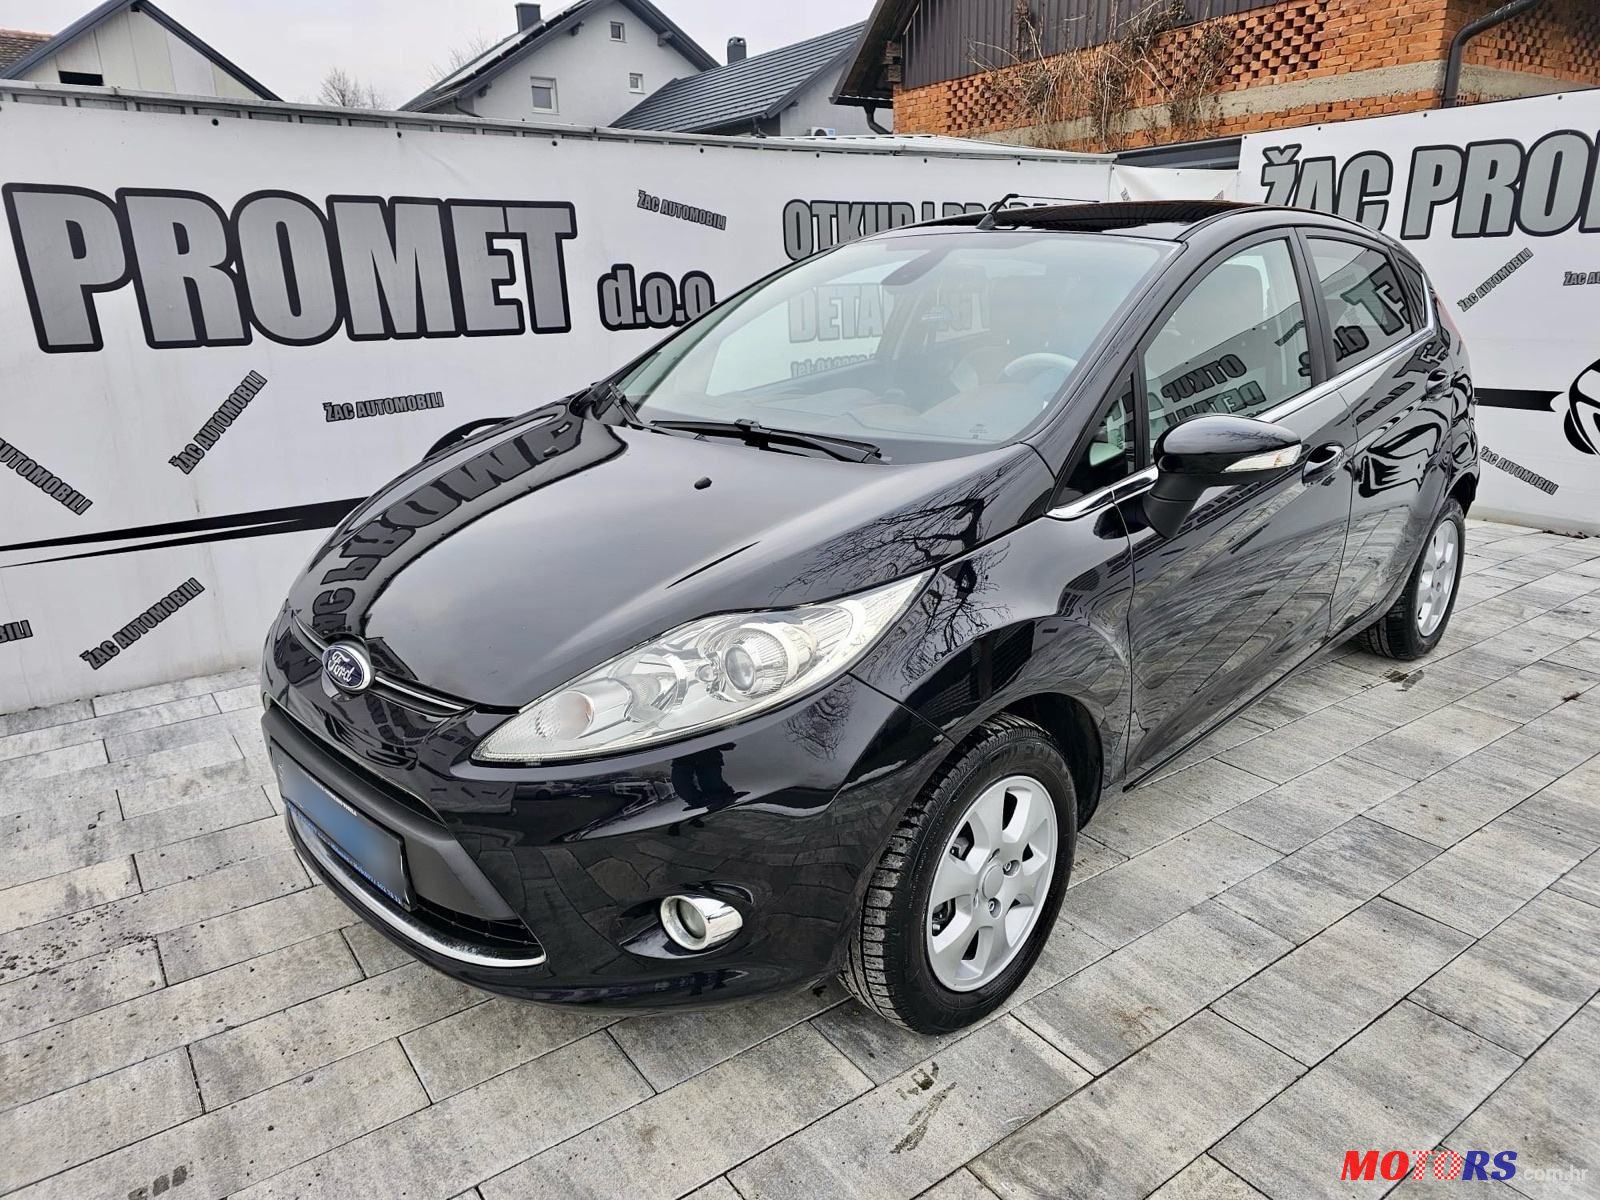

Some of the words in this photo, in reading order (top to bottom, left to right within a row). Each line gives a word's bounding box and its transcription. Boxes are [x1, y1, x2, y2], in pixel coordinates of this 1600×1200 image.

[637, 189, 660, 212] ŽAC
[660, 199, 727, 231] AUTOMOBILI
[1400, 129, 1600, 240] PRO
[2, 183, 577, 353] PROMET
[1457, 292, 1479, 312] ŽAC
[1475, 247, 1534, 299] AUTOMOBILI
[1563, 271, 1587, 286] ŽAC
[168, 443, 205, 475] ŽAC
[193, 369, 268, 451] AUTOMOBILI
[322, 402, 355, 422] ŽAC
[356, 391, 445, 418] AUTOMOBILI
[0, 437, 93, 516] UTOMOBILI
[1495, 457, 1560, 496] AUTOMOBILI
[79, 640, 120, 671] ŽAC
[112, 576, 205, 650] AUTOMOBILI
[327, 650, 355, 682] Ford
